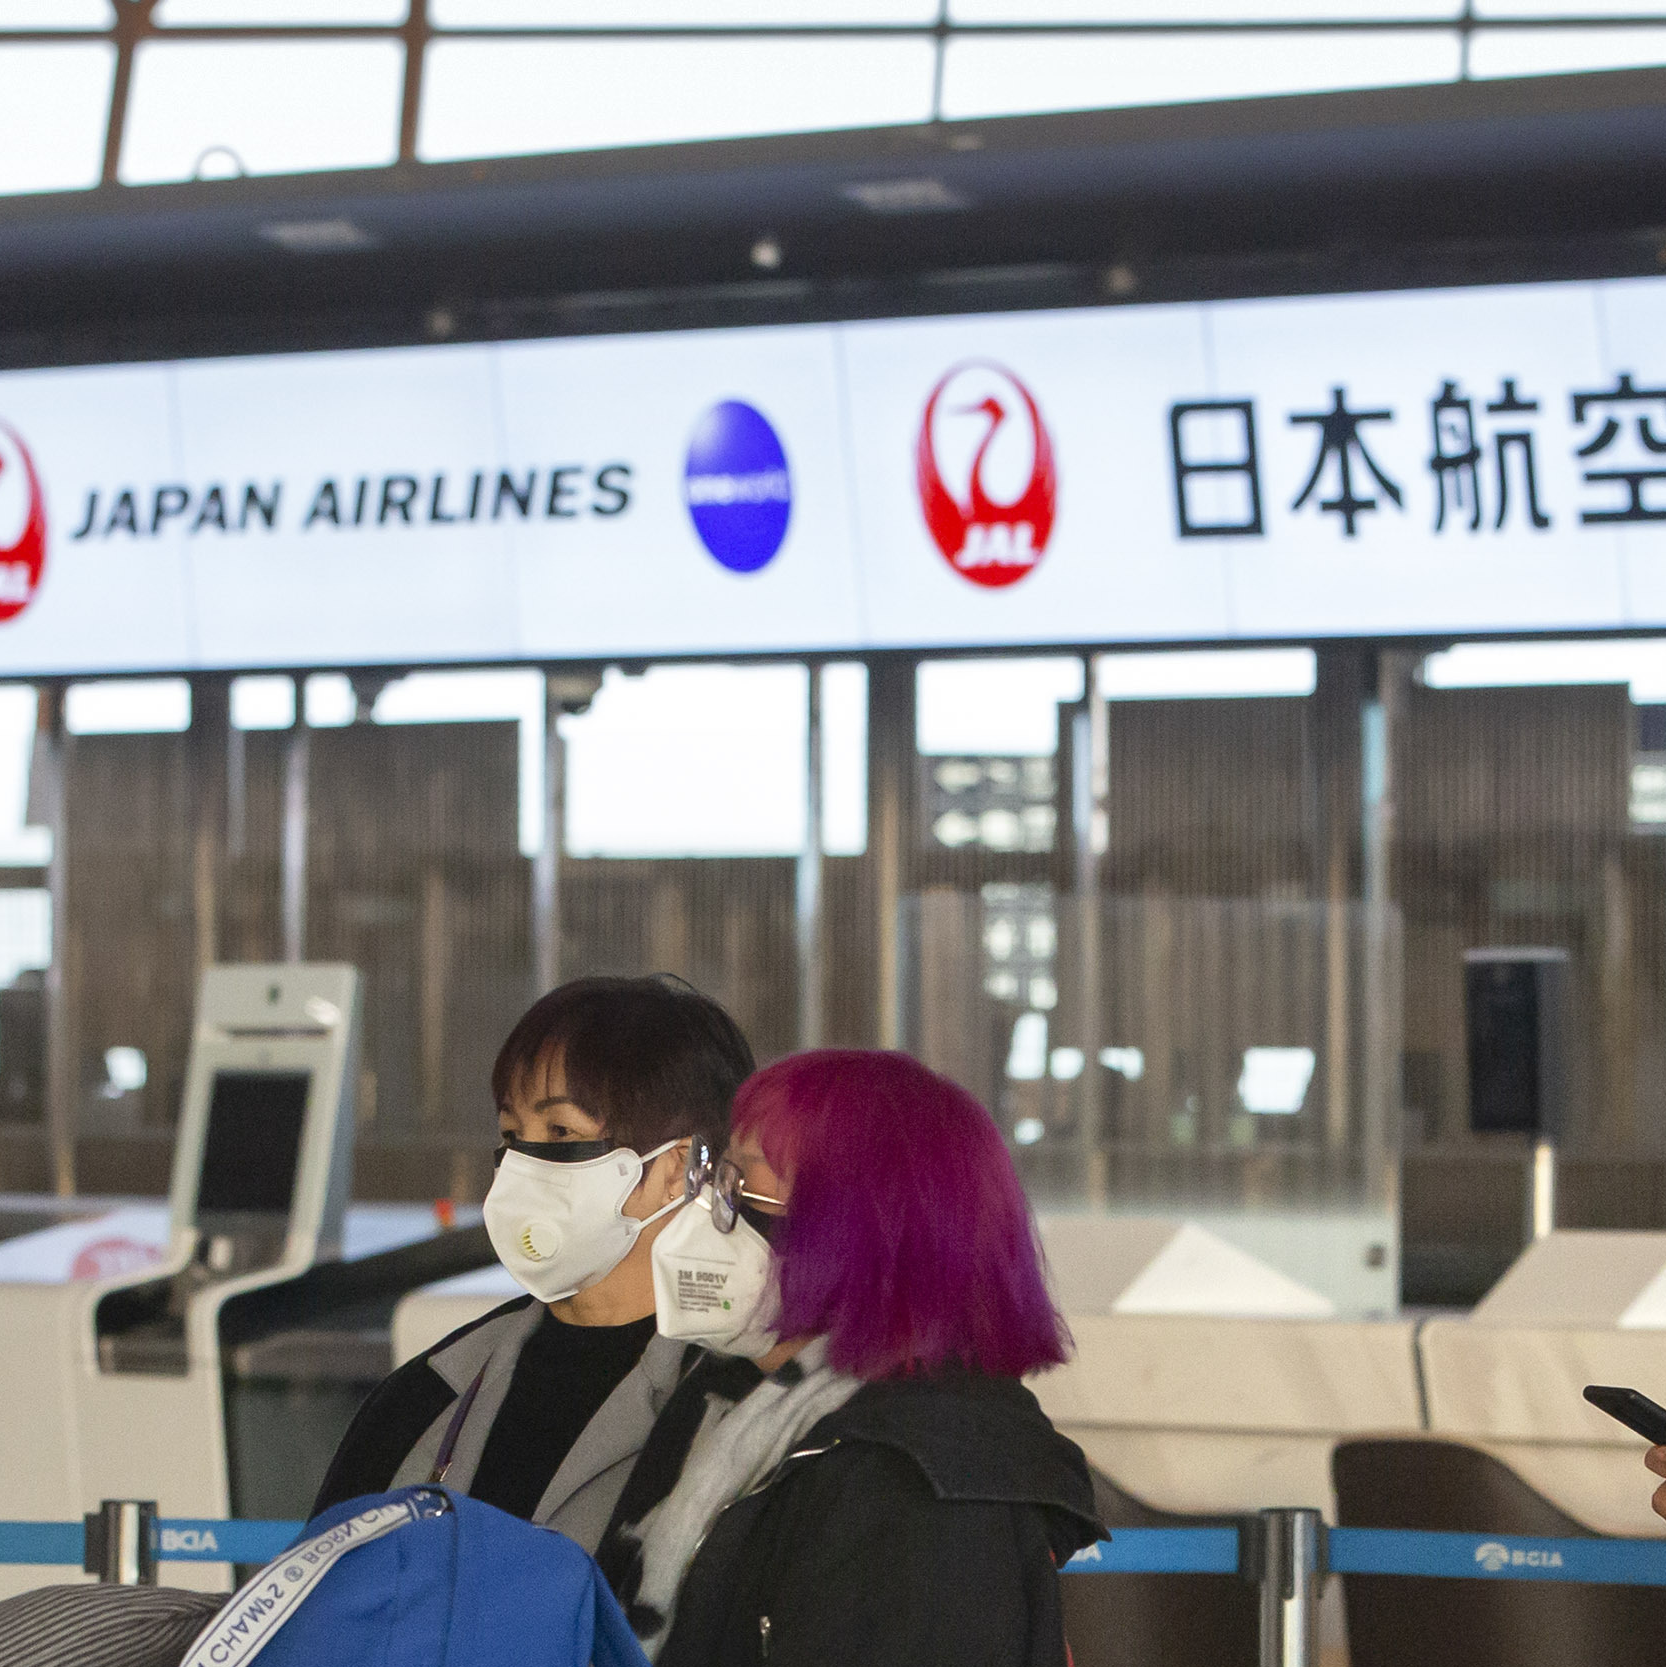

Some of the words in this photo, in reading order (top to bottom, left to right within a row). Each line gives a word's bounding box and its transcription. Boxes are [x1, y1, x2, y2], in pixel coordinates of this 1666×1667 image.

[69, 478, 284, 541] JAPAN
[302, 462, 636, 528] AIRLINES
[954, 520, 1041, 568] JAL
[1512, 1550, 1564, 1569] BCIA
